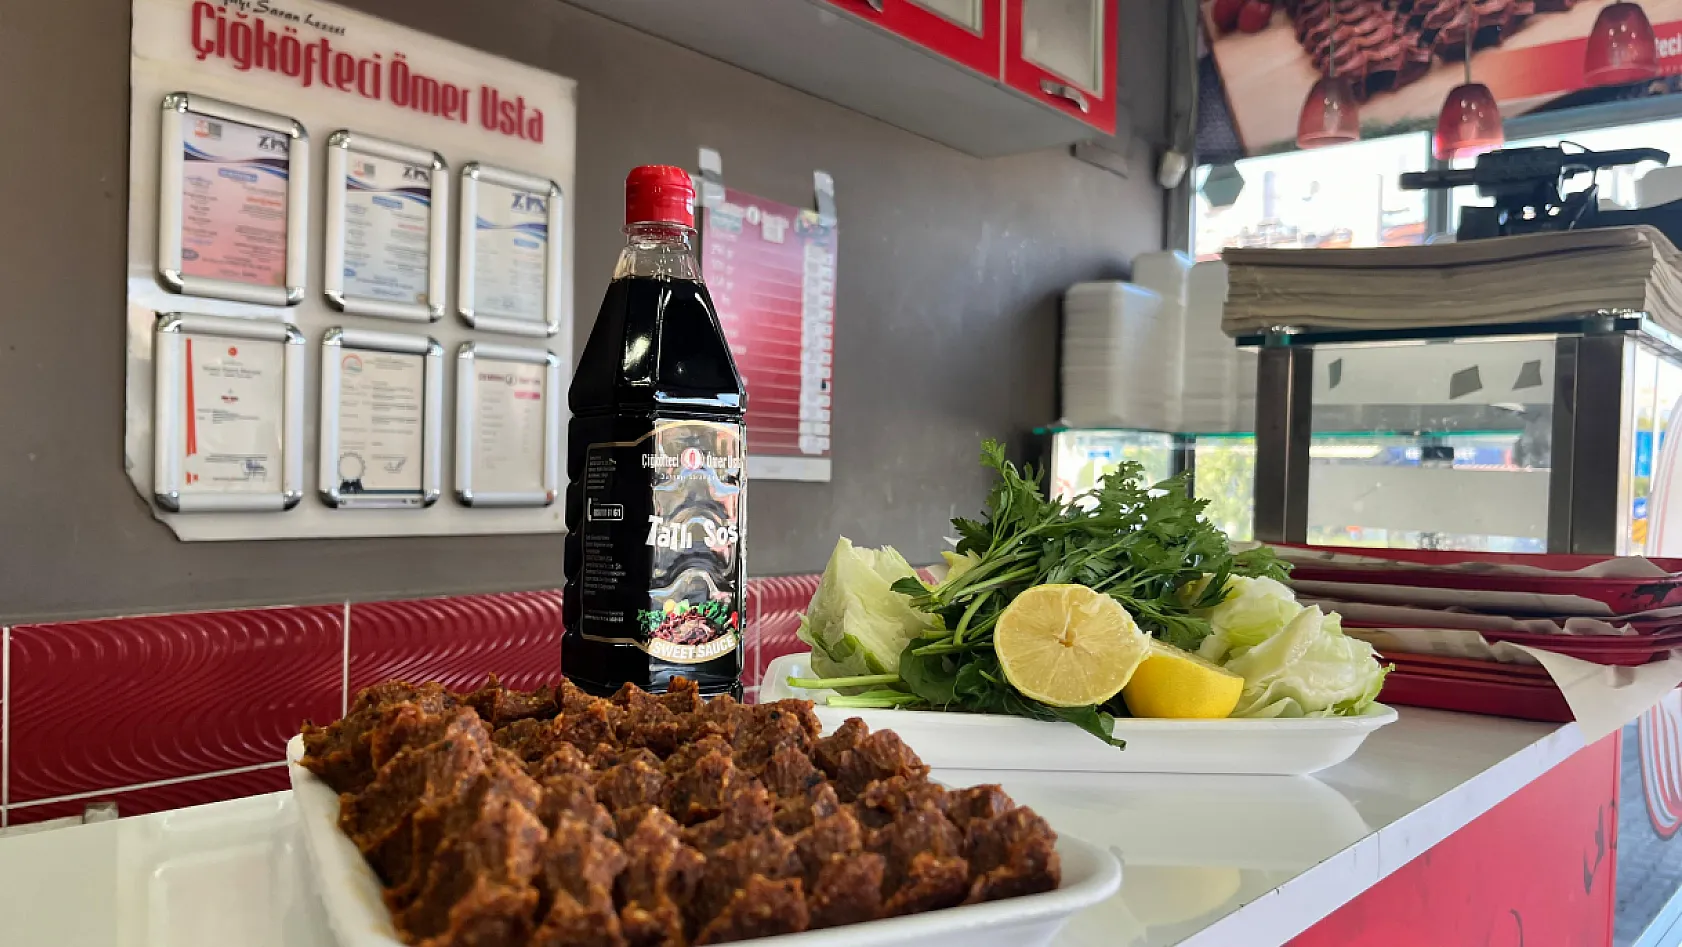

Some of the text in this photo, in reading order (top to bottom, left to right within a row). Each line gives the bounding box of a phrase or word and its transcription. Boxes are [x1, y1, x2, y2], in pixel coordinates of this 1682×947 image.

[192, 1, 544, 144] Çiğköfteci Ömer Usta
[652, 635, 735, 659] SWEET SAUCE
